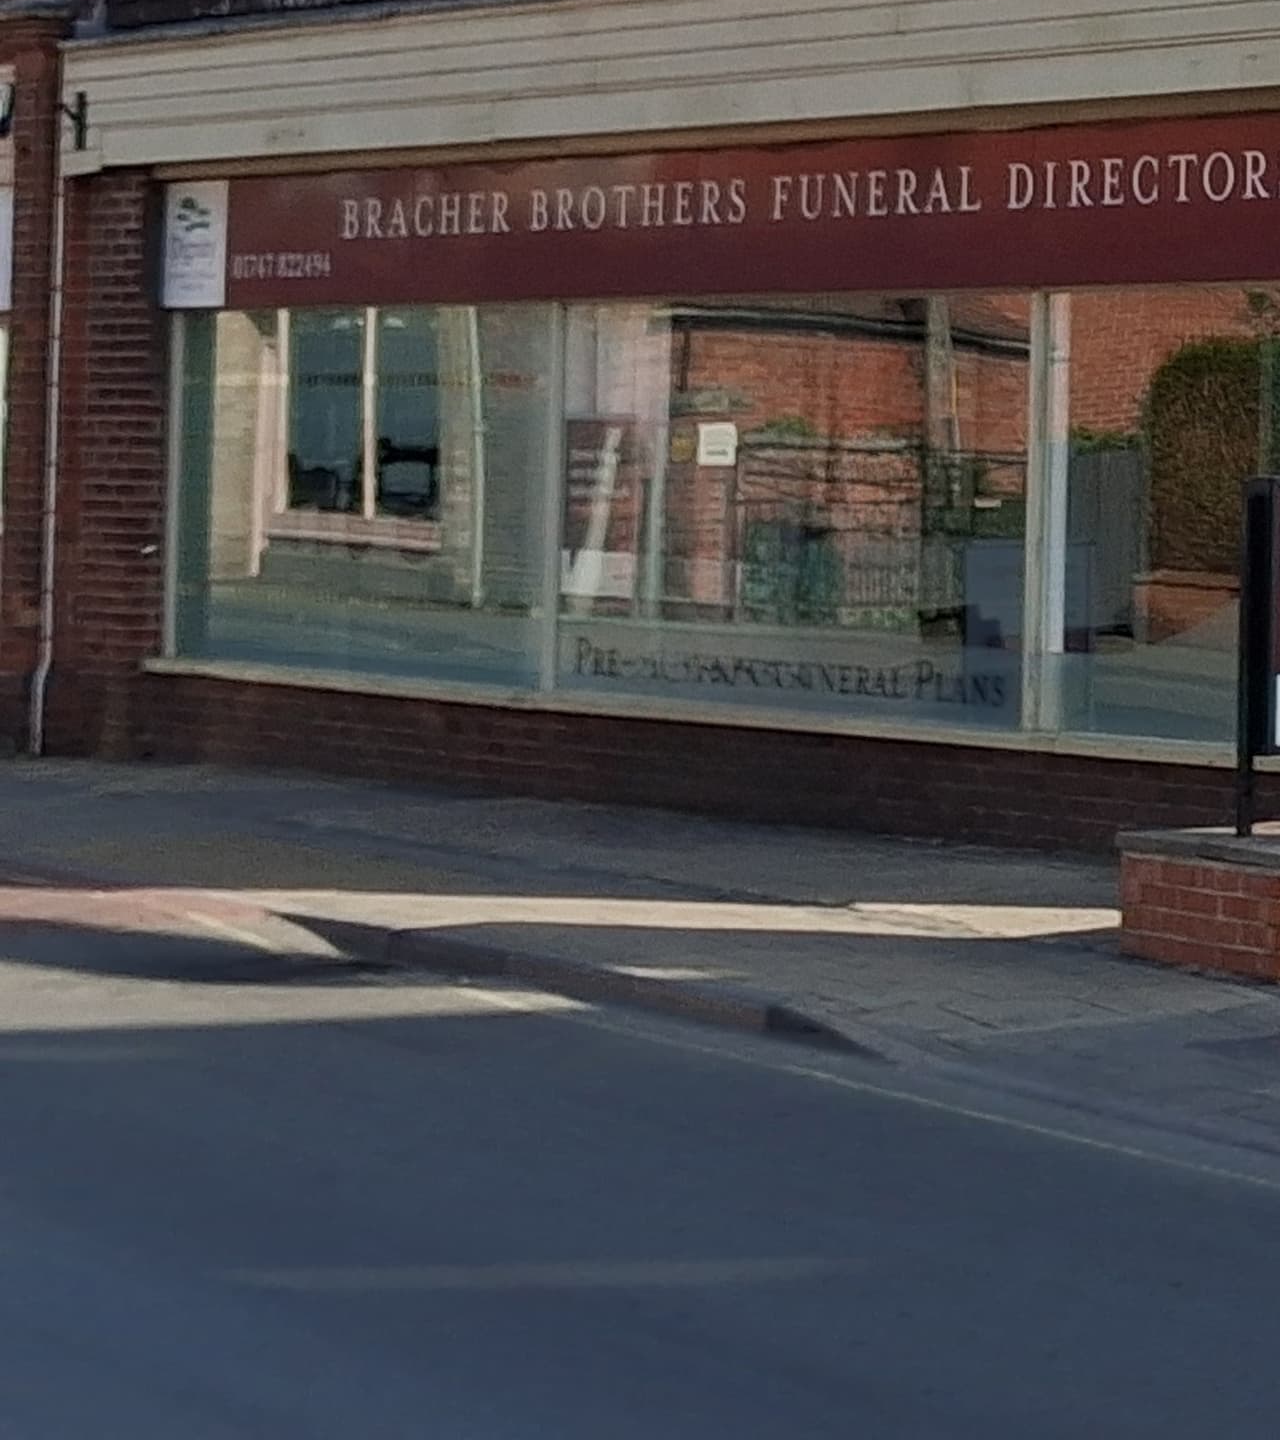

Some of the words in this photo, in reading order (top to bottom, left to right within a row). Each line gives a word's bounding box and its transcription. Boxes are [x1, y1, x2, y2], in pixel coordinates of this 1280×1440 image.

[340, 191, 511, 240] BRACHER
[530, 178, 747, 231] BROTHERS
[772, 165, 982, 220] FUNERAL
